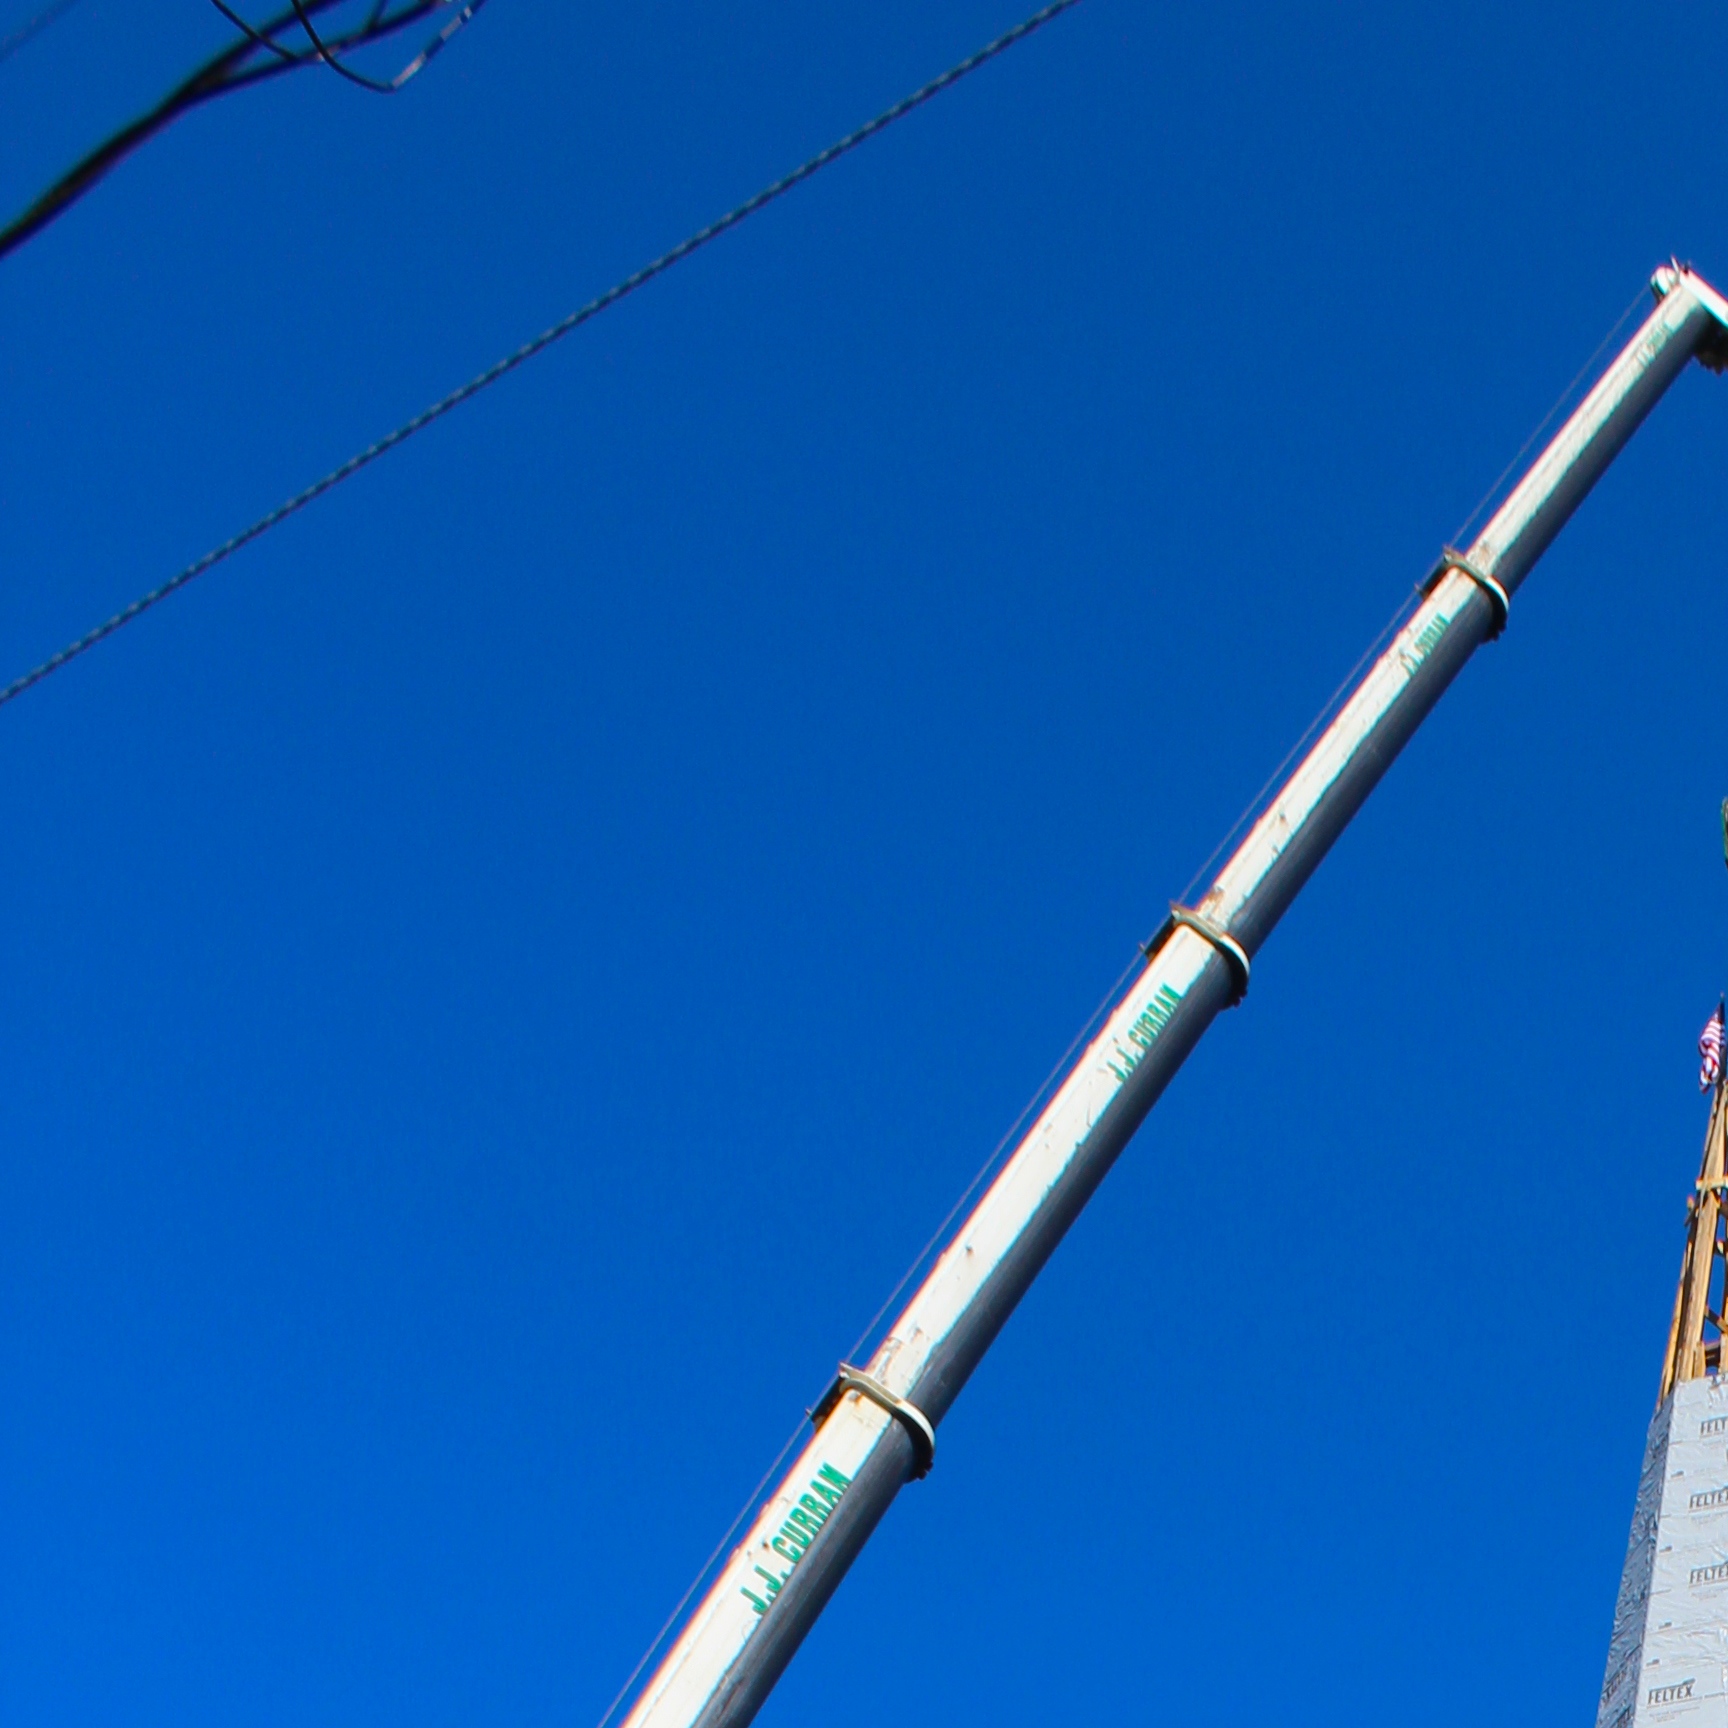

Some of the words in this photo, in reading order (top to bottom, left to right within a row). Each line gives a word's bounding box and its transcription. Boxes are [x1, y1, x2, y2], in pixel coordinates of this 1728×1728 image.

[741, 1565, 790, 1615] J.J.
[772, 1461, 853, 1563] CURRAN
[1648, 1680, 1694, 1705] FELTEX
